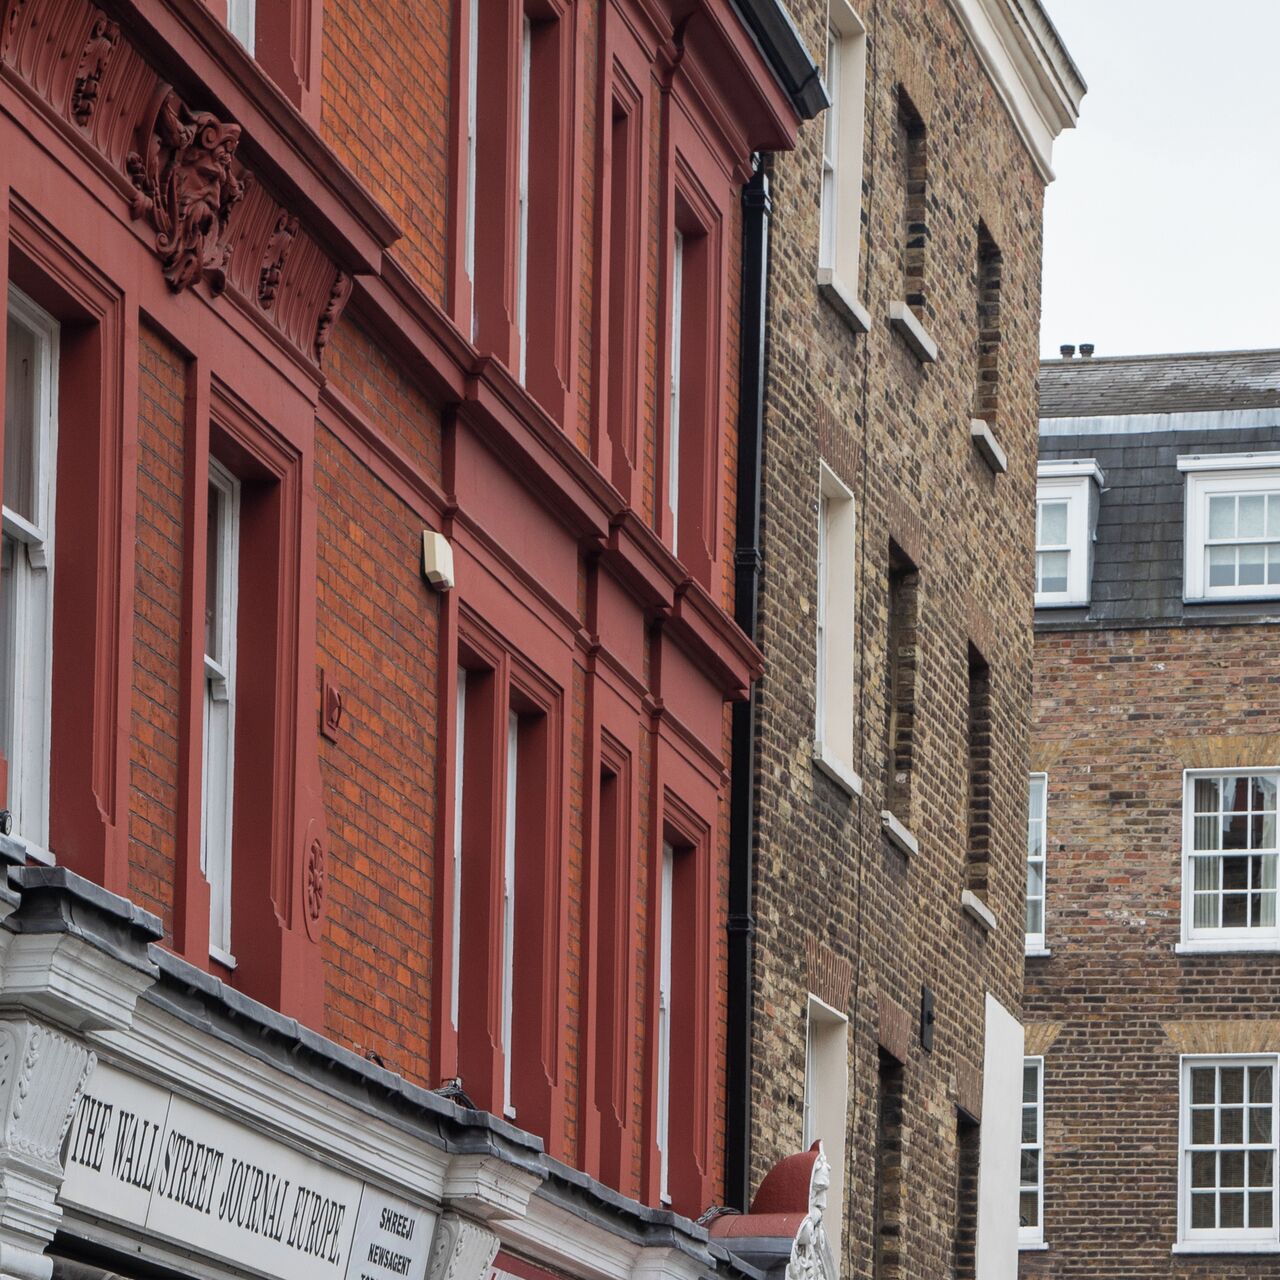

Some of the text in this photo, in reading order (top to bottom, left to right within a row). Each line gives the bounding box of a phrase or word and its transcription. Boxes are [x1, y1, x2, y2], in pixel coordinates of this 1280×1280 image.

[70, 1094, 114, 1173] THE
[110, 1110, 160, 1193] WALL
[156, 1128, 224, 1215] STREET
[218, 1156, 290, 1246] JOURNAL
[379, 1207, 416, 1242] SHREEJI
[367, 1243, 412, 1276] NEWSAGENT
